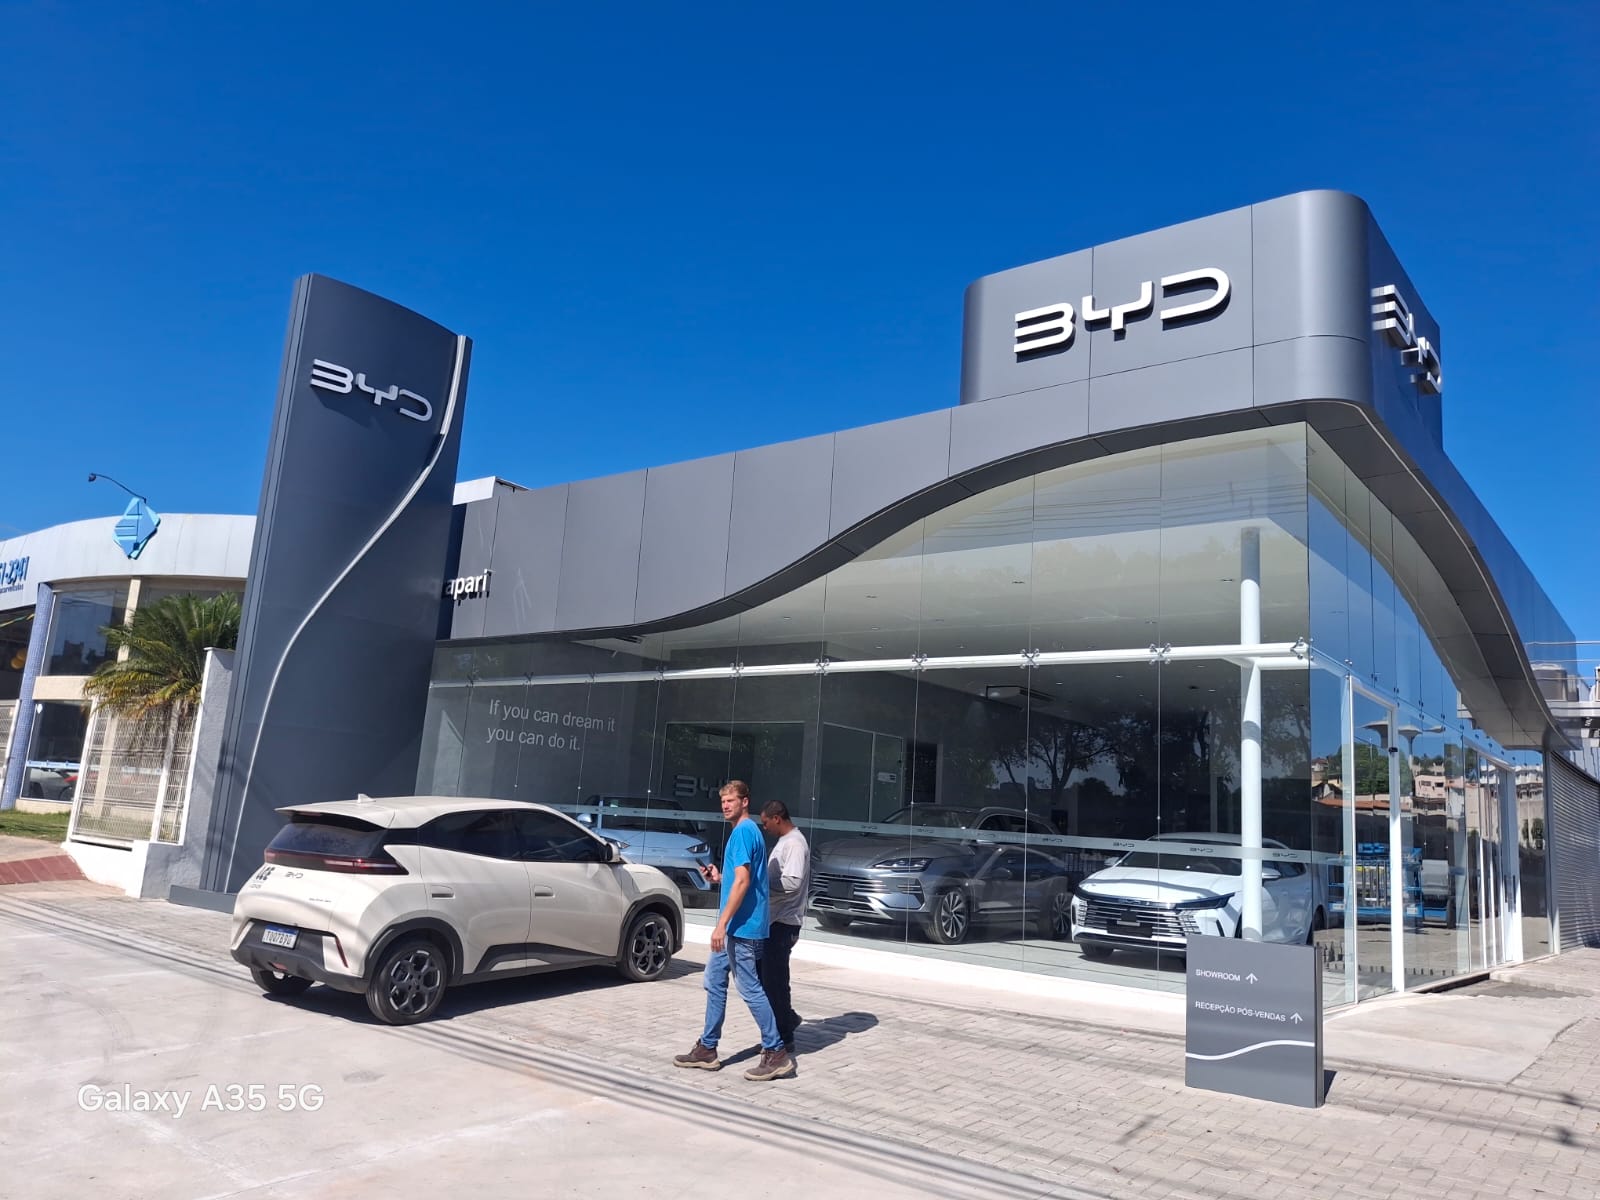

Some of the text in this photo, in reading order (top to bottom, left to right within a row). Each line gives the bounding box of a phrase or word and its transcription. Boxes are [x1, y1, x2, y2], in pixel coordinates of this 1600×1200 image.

[1013, 267, 1231, 354] BYD
[310, 358, 433, 422] BYD
[489, 699, 615, 732] If you can dream it
[486, 727, 581, 751] you can do it.
[1195, 969, 1241, 982] SHOWROOM
[1195, 1001, 1286, 1022] RECEPÇÃO PÓS-VENDAS
